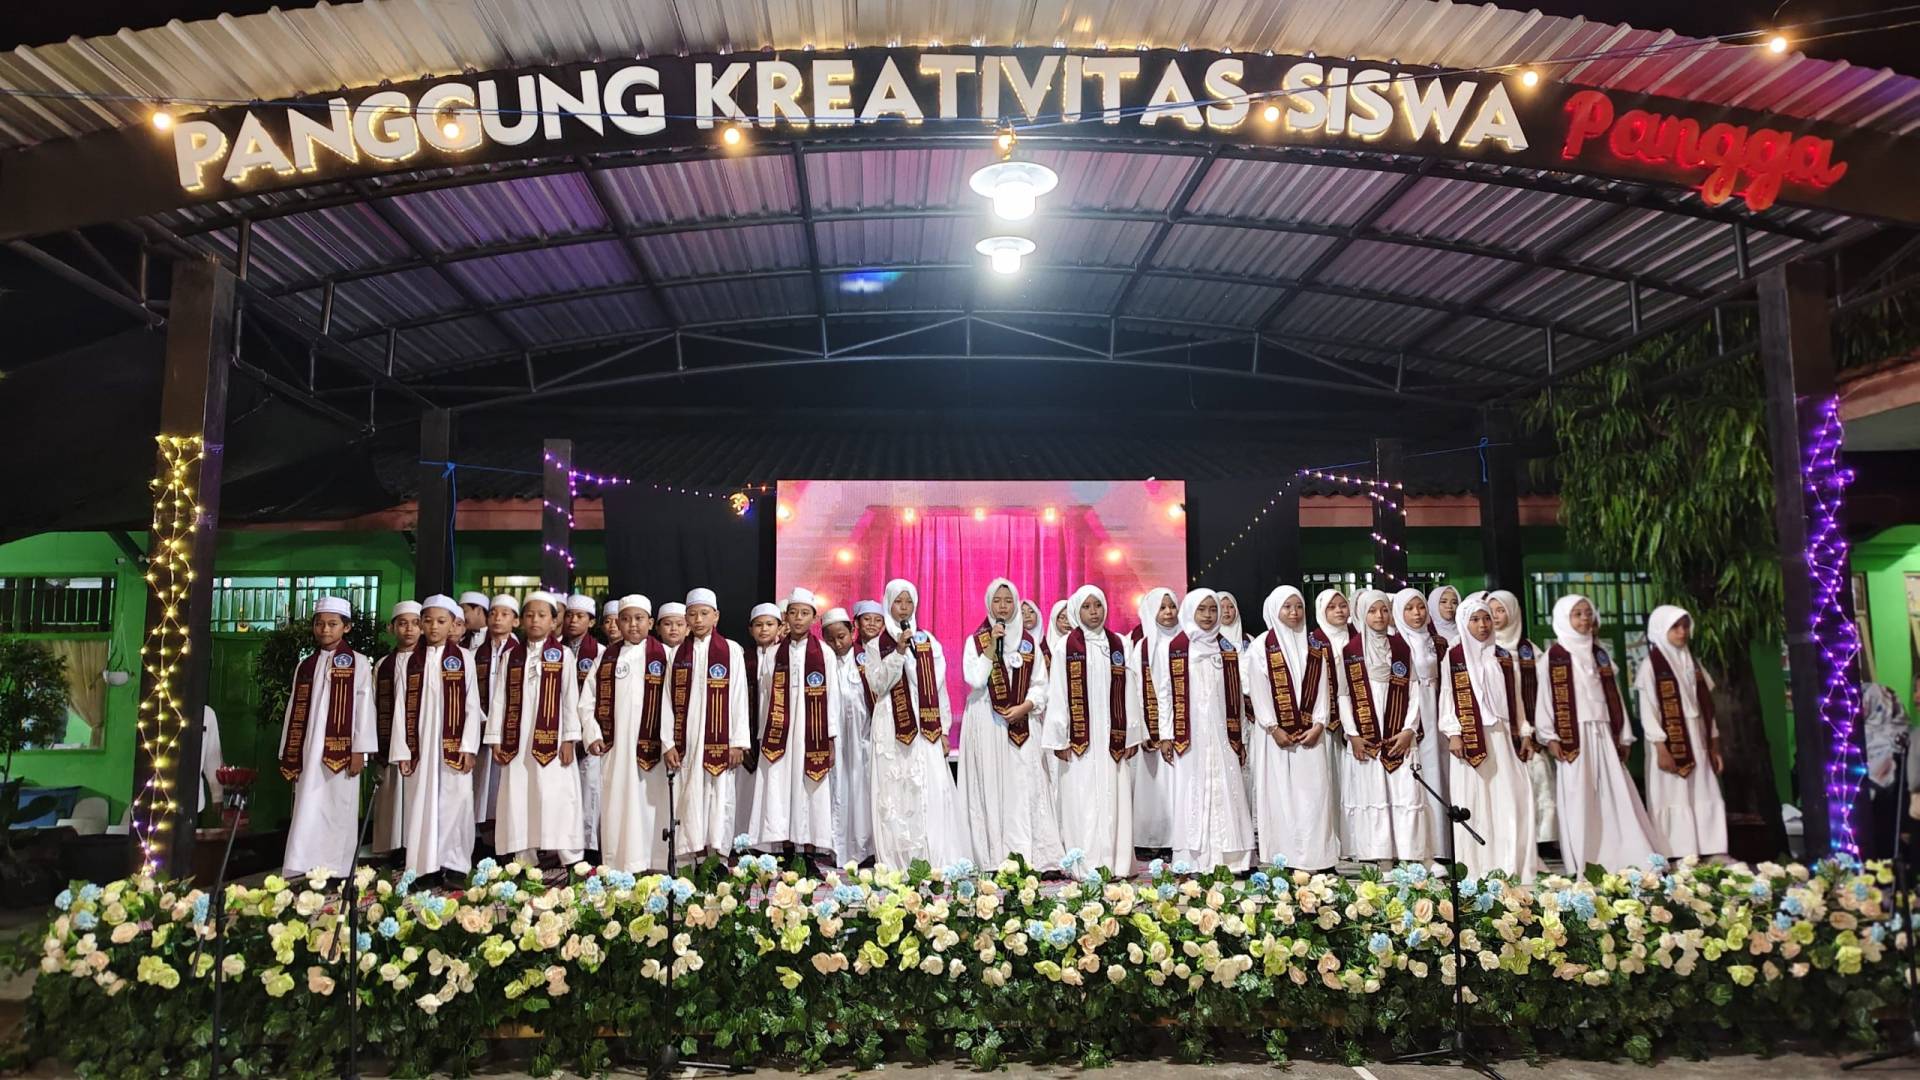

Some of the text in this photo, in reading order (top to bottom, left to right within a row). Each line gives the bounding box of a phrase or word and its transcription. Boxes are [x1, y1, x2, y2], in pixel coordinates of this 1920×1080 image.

[173, 53, 1530, 192] PANGGUNG KREATIVITAS SISWA
[1562, 89, 1848, 212] Pangga
